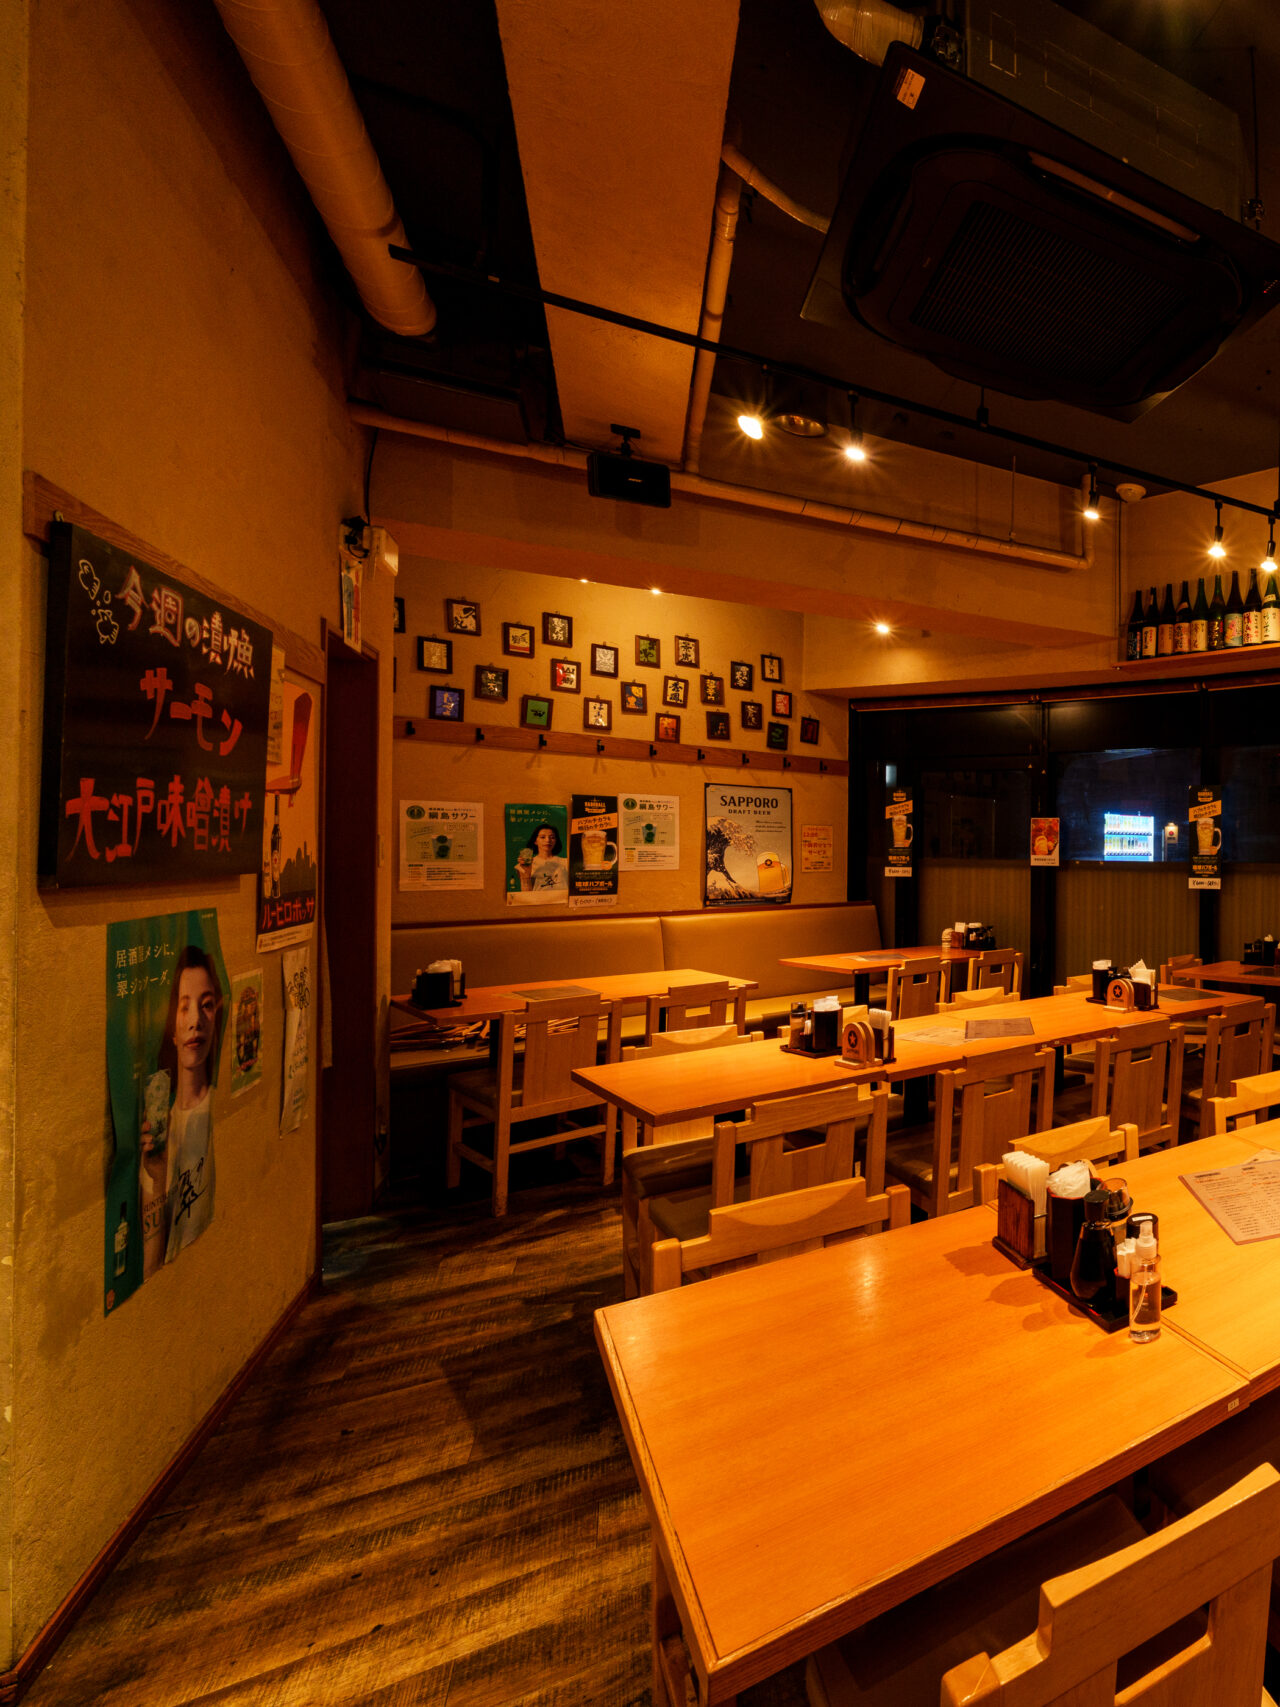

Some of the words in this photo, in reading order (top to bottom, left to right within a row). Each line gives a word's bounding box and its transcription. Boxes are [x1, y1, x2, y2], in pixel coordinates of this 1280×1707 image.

[115, 565, 256, 679] 今週の漬け魚
[139, 667, 243, 756] サーモン
[65, 774, 252, 863] 大江戸味噌漬け
[720, 795, 779, 809] SAPPORO
